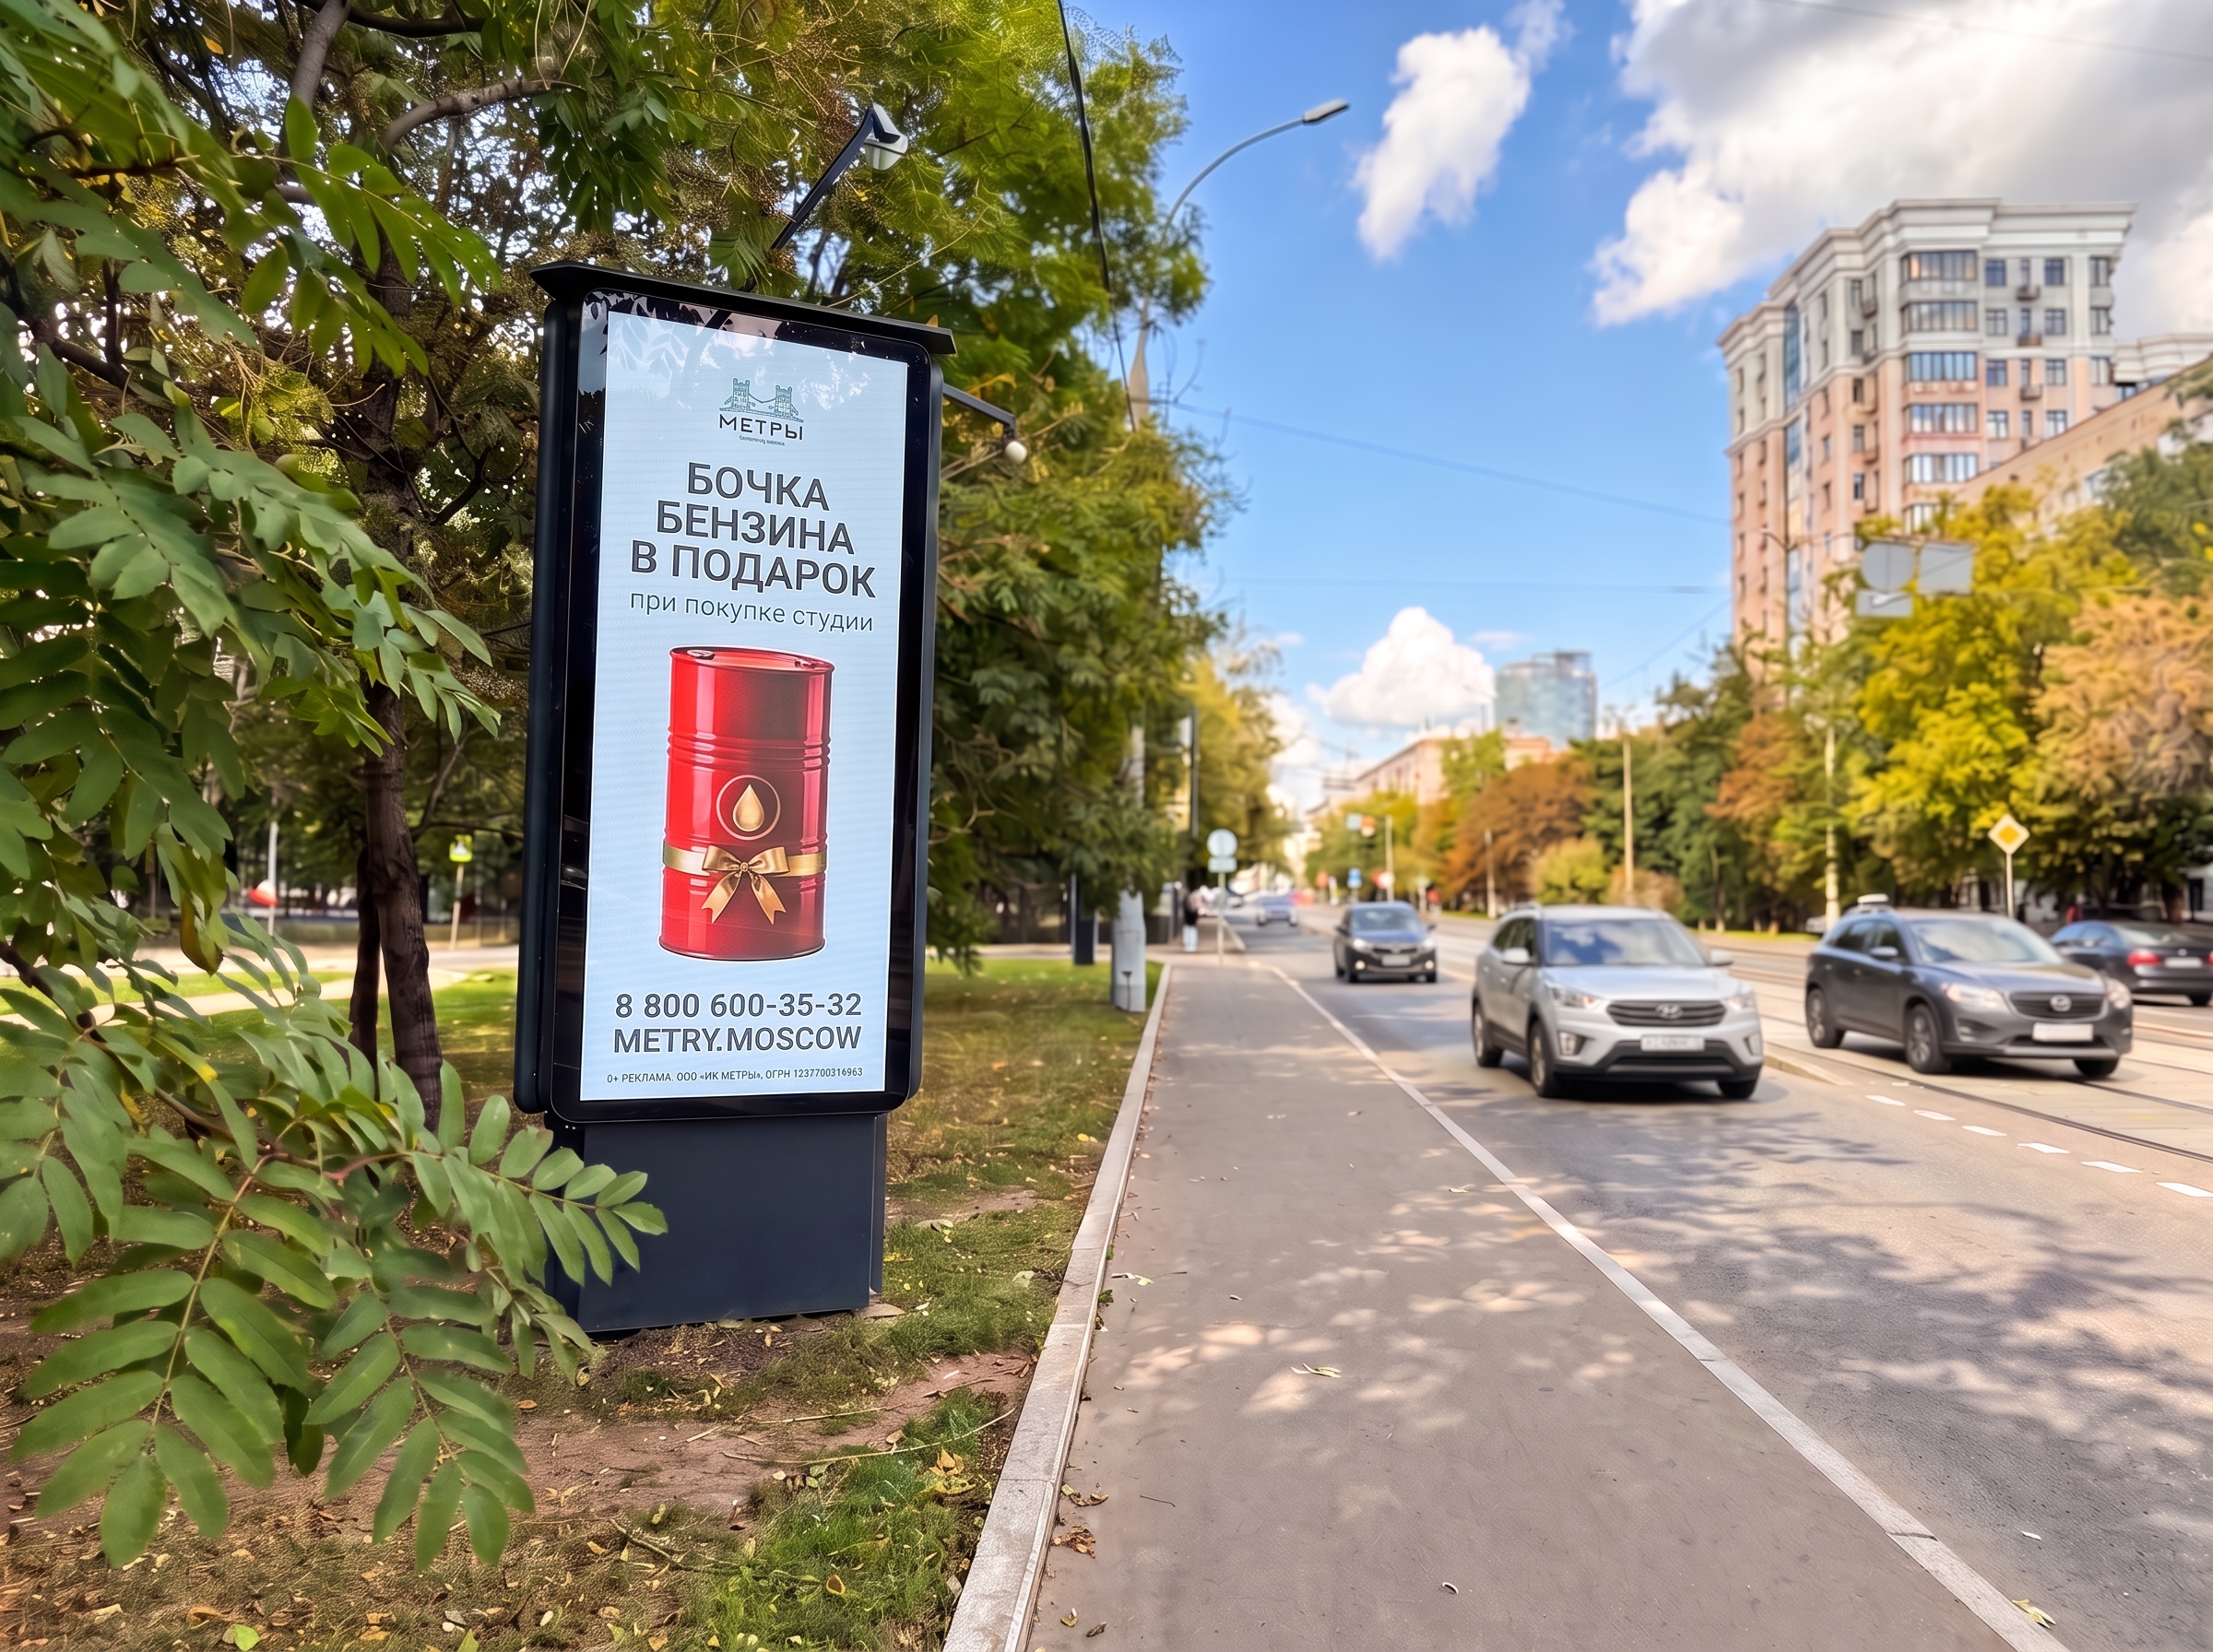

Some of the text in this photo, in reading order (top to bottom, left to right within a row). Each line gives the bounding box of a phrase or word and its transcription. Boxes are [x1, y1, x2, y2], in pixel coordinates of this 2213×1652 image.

[719, 413, 804, 441] МЕТРЫ
[688, 462, 830, 512] БОЧКА
[657, 501, 855, 555] БЕНЗИНА
[632, 540, 876, 598] В ПОДАРОК
[631, 593, 873, 632] при покупке студии
[615, 993, 862, 1019] 8 800 600-35-32
[614, 1026, 862, 1054] METRY.MOSCOW
[607, 1074, 619, 1083] 0+
[621, 1072, 674, 1083] РЕКЛАМА.
[676, 1071, 697, 1081] ООО
[765, 1069, 790, 1080] ОГРН
[794, 1068, 863, 1079] 1237700316963
